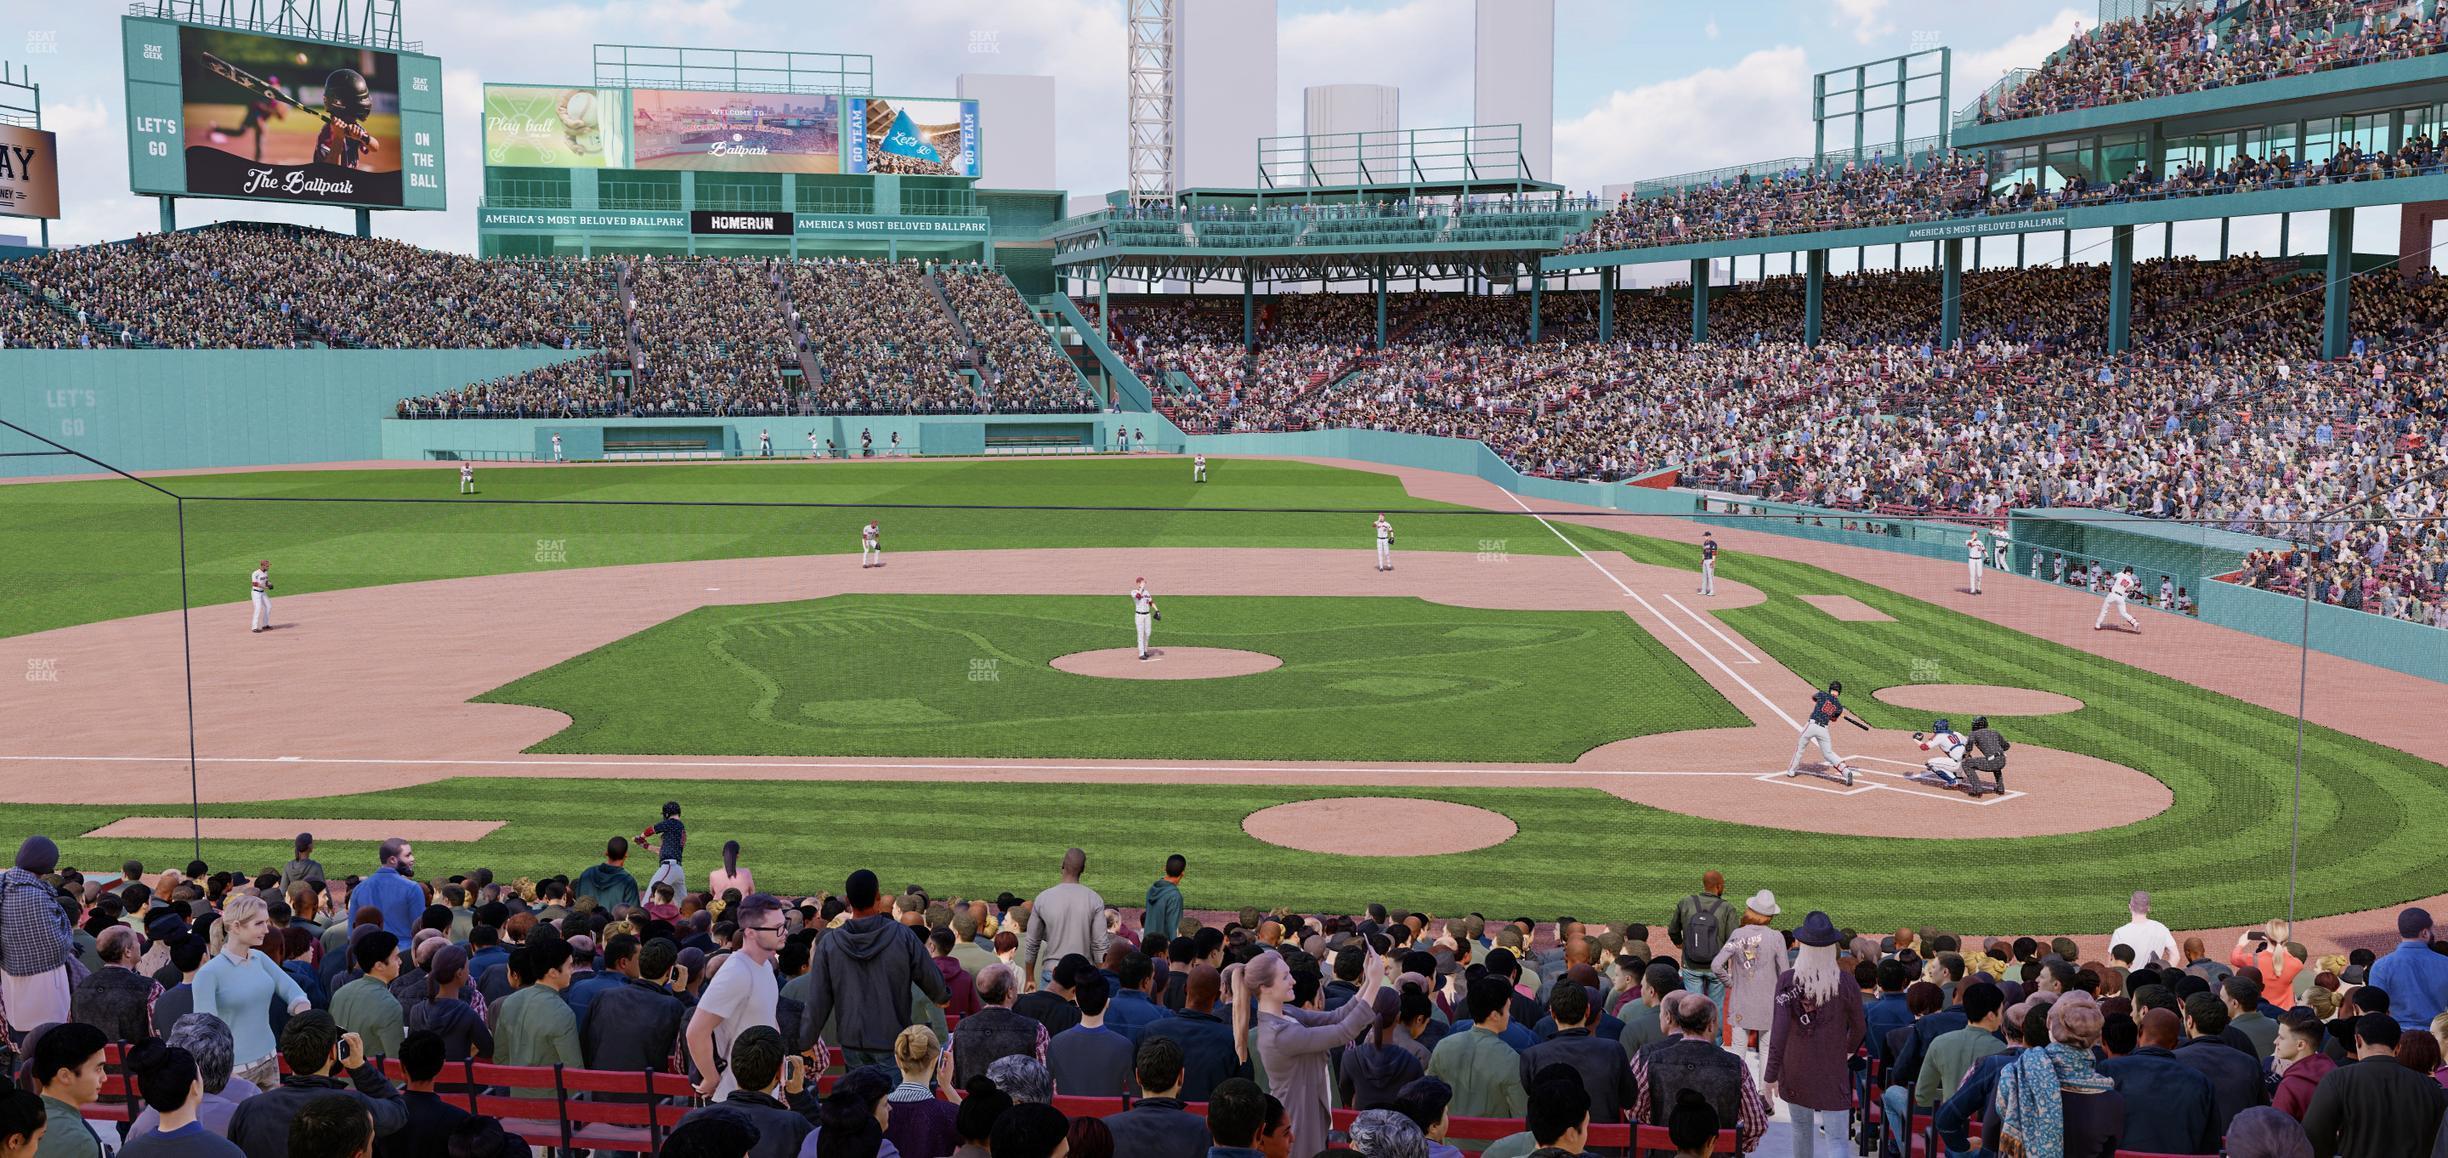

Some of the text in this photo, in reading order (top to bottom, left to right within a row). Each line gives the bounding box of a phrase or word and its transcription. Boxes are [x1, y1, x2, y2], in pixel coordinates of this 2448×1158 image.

[143, 44, 162, 53] SEAT
[143, 52, 163, 60] GEEK
[137, 117, 176, 134] LET'S
[488, 117, 553, 136] Play ball
[415, 132, 430, 146] ON
[853, 110, 863, 162] GO TEAM
[892, 131, 918, 146] Let's
[965, 114, 974, 165] GO TEAM
[149, 141, 167, 156] GO
[708, 141, 768, 157] Ballpark
[412, 153, 434, 167] THE
[244, 168, 353, 196] The Ballpark
[410, 174, 437, 188] BALL
[485, 215, 684, 226] AMERICA'S MOST BELOVED BALLPARK
[711, 216, 774, 230] HOMERUN
[798, 219, 986, 232] AMERICA'S MOST BELOVED BALLPARK
[1909, 217, 2065, 238] AMERICA'S MOST BELOVED BALLPARK
[47, 389, 96, 407] LET'S
[62, 419, 84, 436] GO
